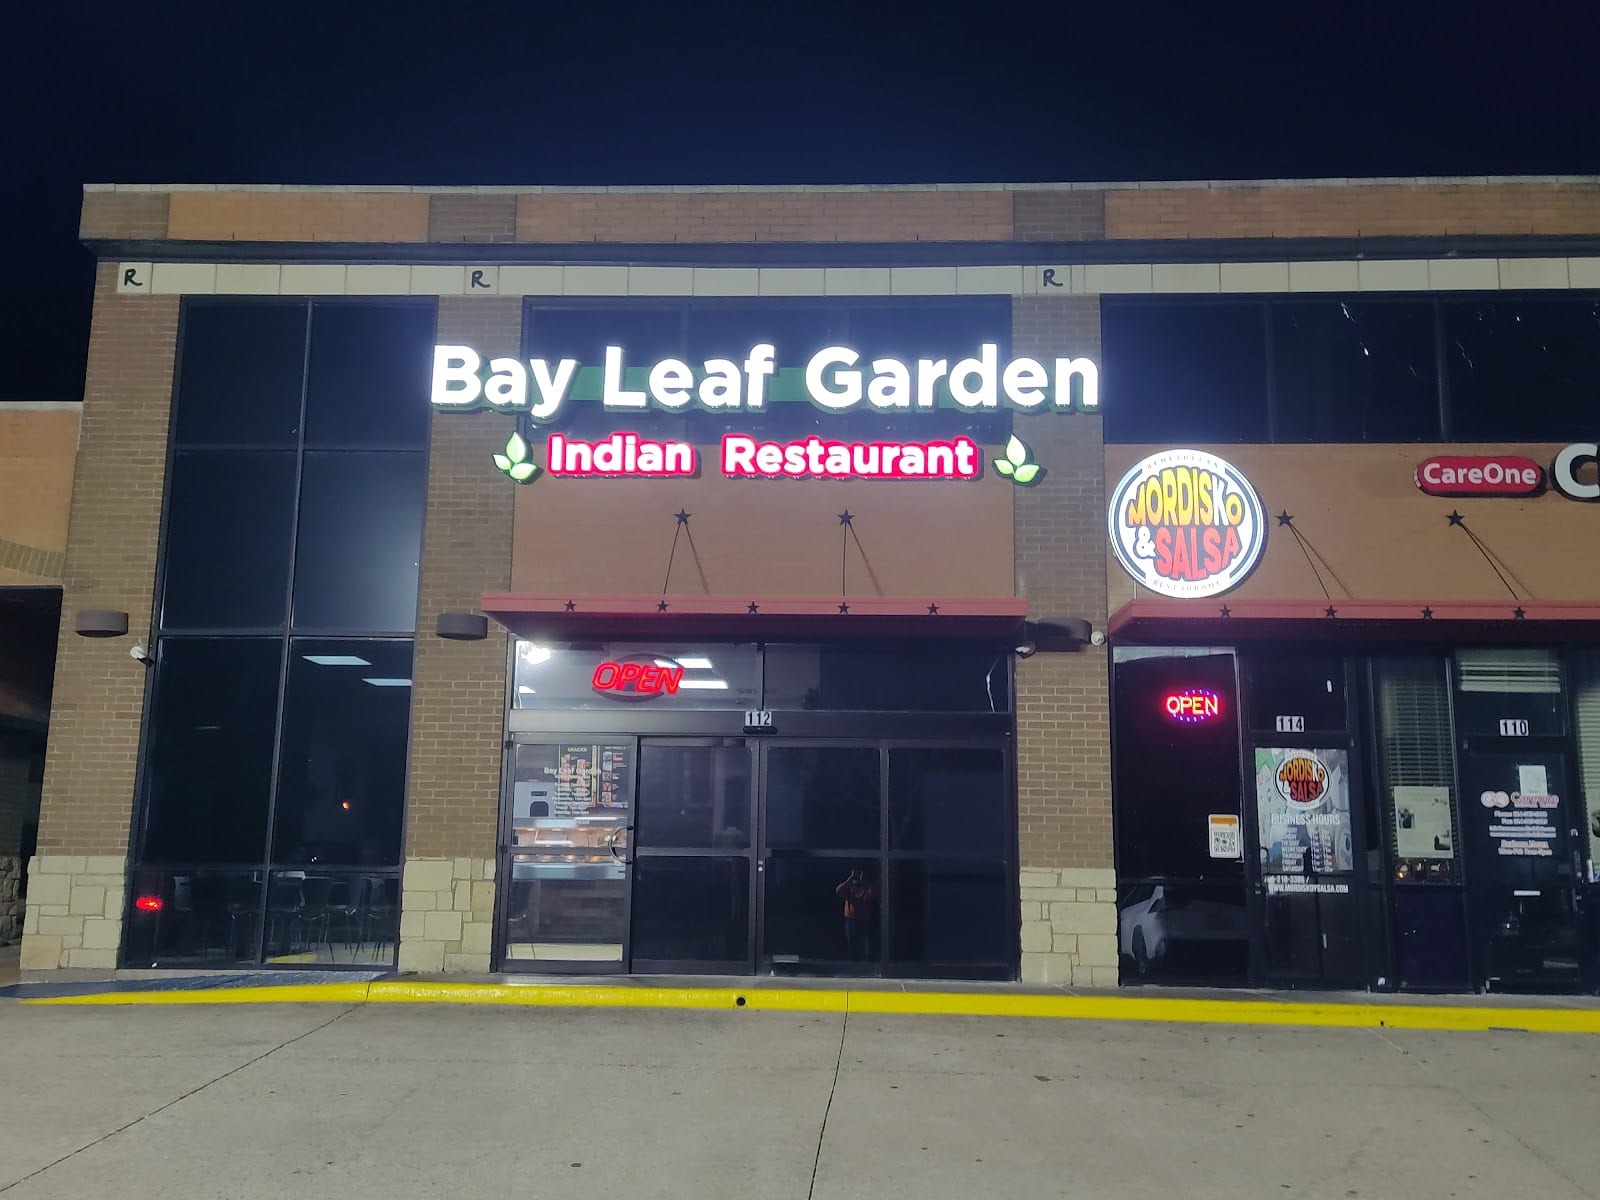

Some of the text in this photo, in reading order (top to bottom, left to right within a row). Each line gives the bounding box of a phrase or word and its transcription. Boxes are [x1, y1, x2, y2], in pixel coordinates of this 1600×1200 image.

[124, 268, 143, 286] R
[472, 270, 491, 288] R
[1043, 269, 1064, 287] R
[431, 343, 1099, 418] Bay Leaf Garden
[550, 434, 974, 476] Indian Restaurant
[1423, 462, 1537, 485] CareOne
[1127, 465, 1244, 527] MORDISKO
[1135, 526, 1241, 580] & SALSA
[592, 661, 685, 695] OPEN
[1166, 695, 1219, 715] OPEN
[747, 711, 771, 726] 112
[1278, 716, 1303, 732] 114
[1502, 720, 1528, 736] 110
[1280, 757, 1326, 782] MORDISKO
[1290, 780, 1324, 802] SALSA
[1312, 814, 1341, 826] HOURS
